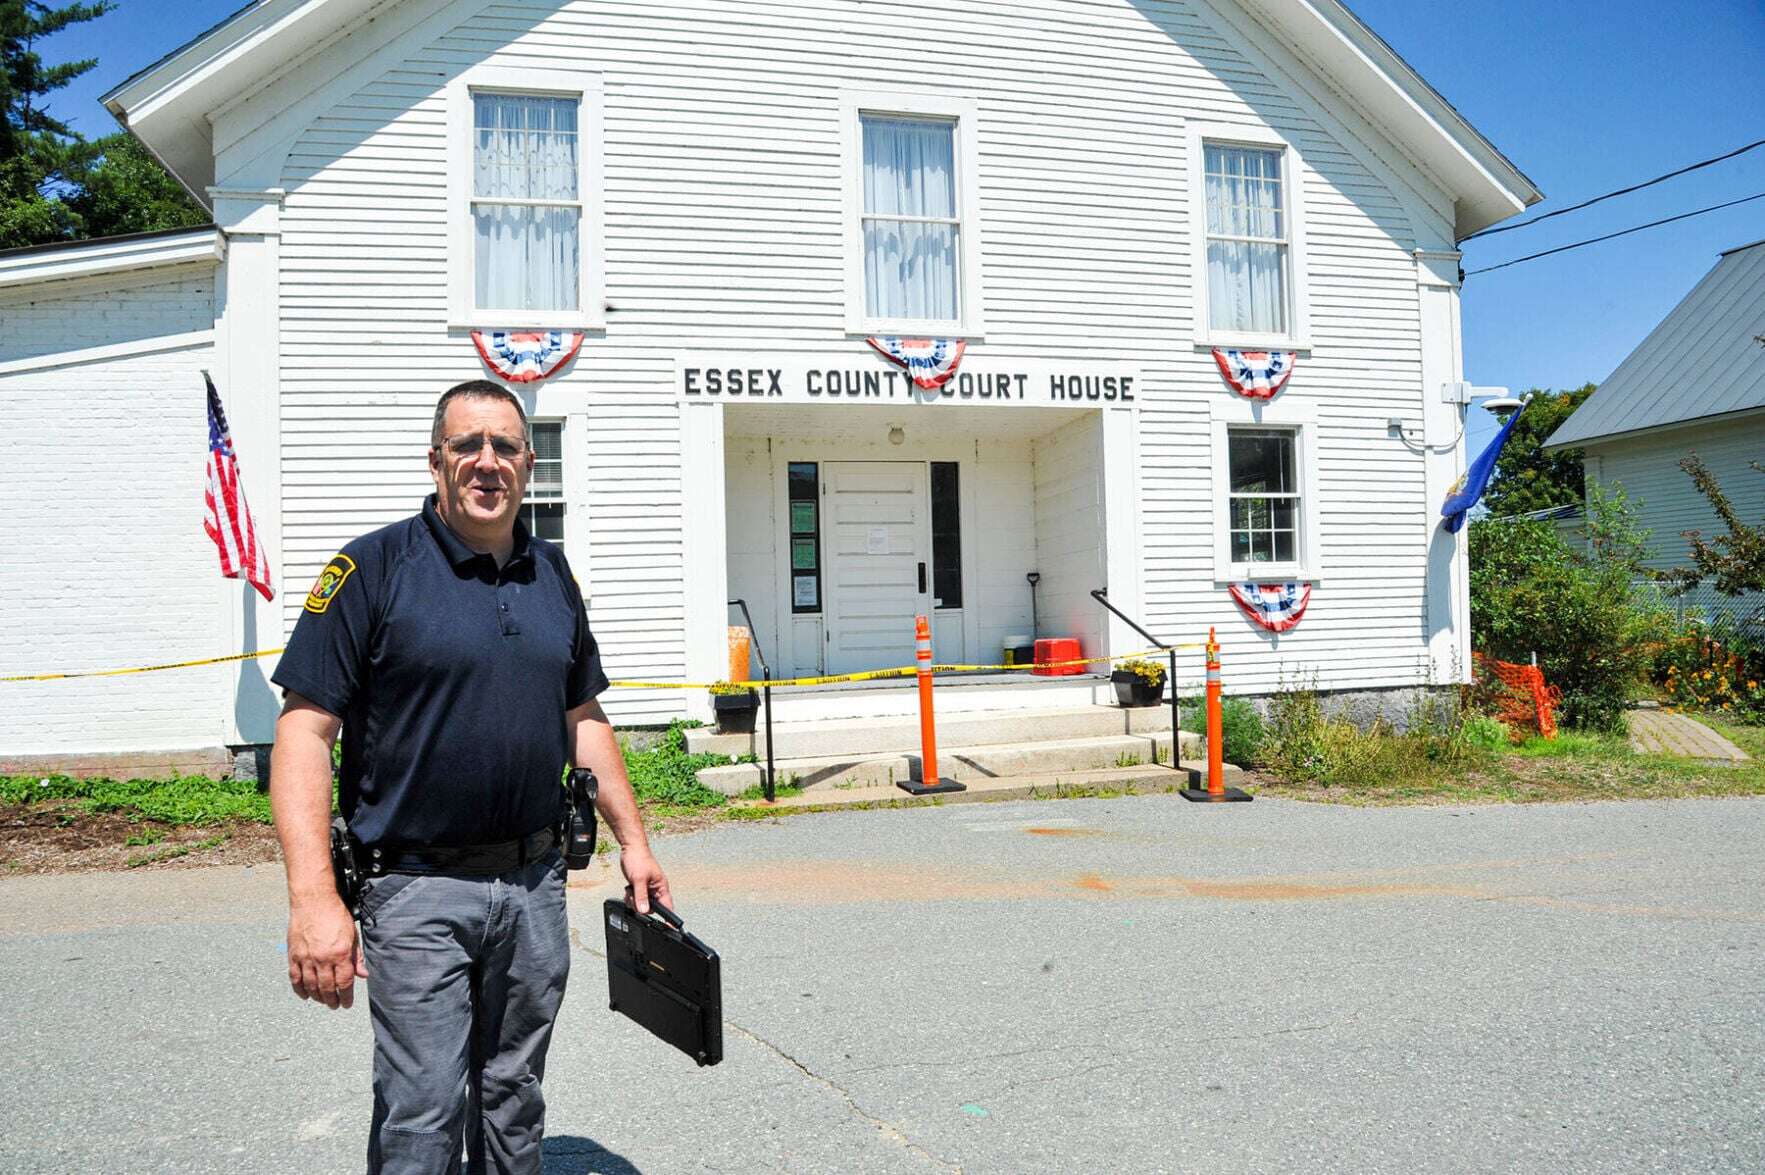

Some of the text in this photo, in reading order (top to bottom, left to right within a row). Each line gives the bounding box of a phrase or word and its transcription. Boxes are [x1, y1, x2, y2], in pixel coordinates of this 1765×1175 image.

[684, 368, 783, 396] ESSEX
[806, 369, 914, 398] COUNTY
[1050, 374, 1135, 401] HOUSE
